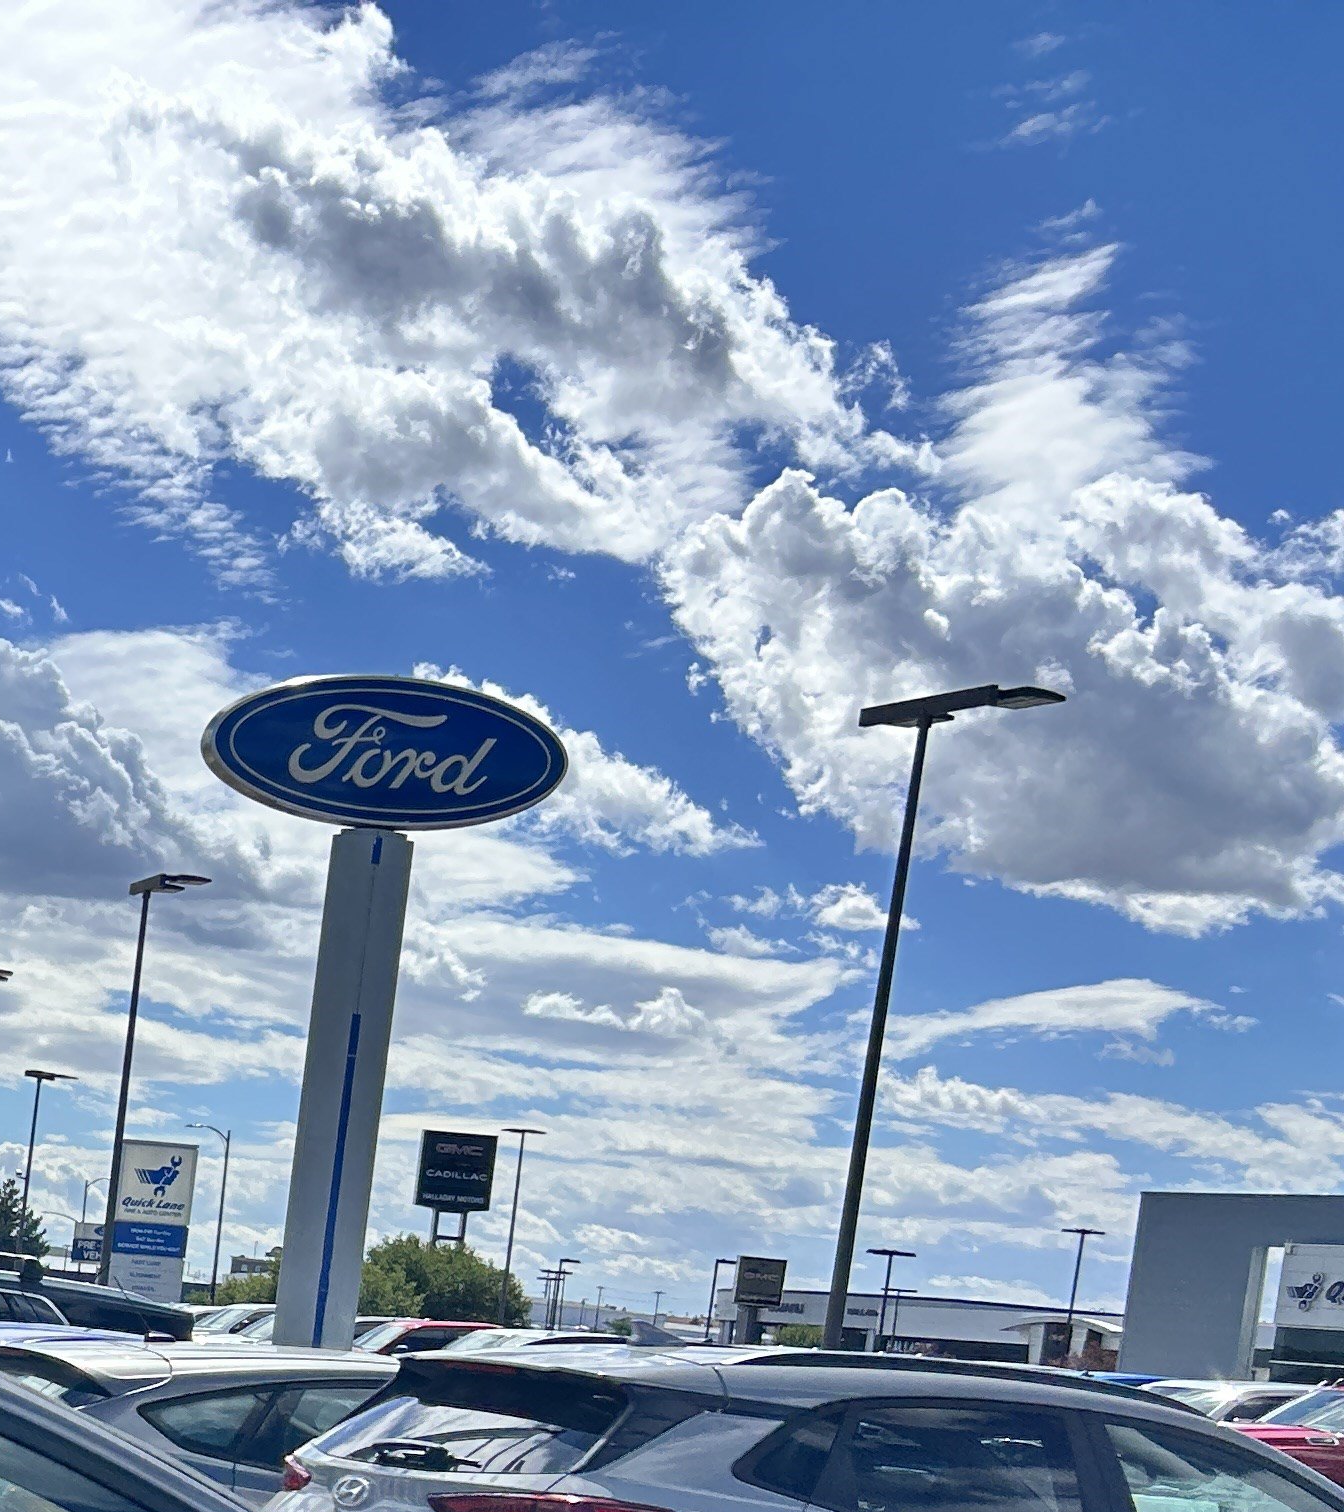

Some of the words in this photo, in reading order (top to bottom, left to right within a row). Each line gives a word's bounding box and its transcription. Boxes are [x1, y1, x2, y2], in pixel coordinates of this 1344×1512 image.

[288, 703, 498, 796] Ford
[435, 1143, 484, 1156] GMC
[425, 1168, 488, 1182] CADILLAC
[122, 1197, 154, 1208] Quick
[155, 1200, 185, 1210] Lane
